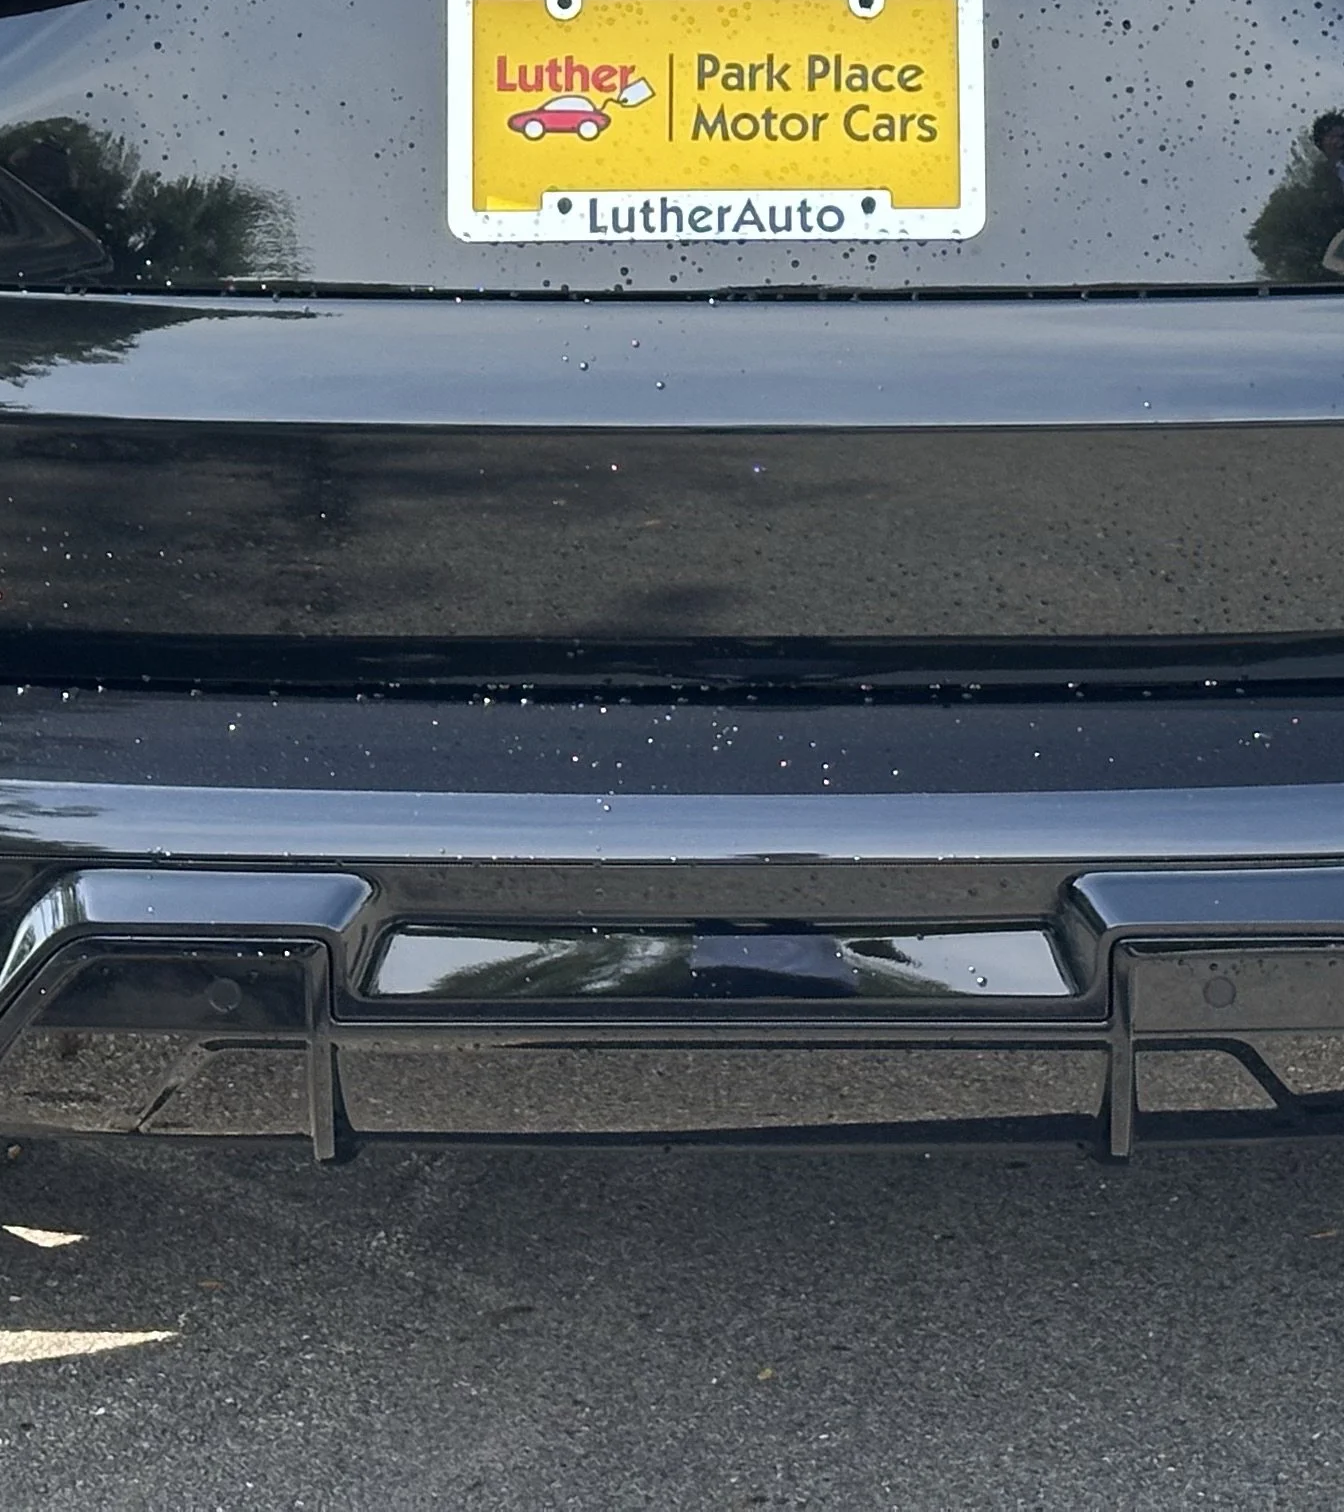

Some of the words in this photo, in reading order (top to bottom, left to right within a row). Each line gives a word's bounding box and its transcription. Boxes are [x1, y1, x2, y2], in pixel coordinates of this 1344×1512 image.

[496, 54, 636, 93] Luther
[695, 53, 791, 93] Park
[807, 53, 925, 93] Place
[690, 103, 830, 143] Motor
[843, 107, 939, 143] Cars
[588, 197, 846, 235] LutherAuto
